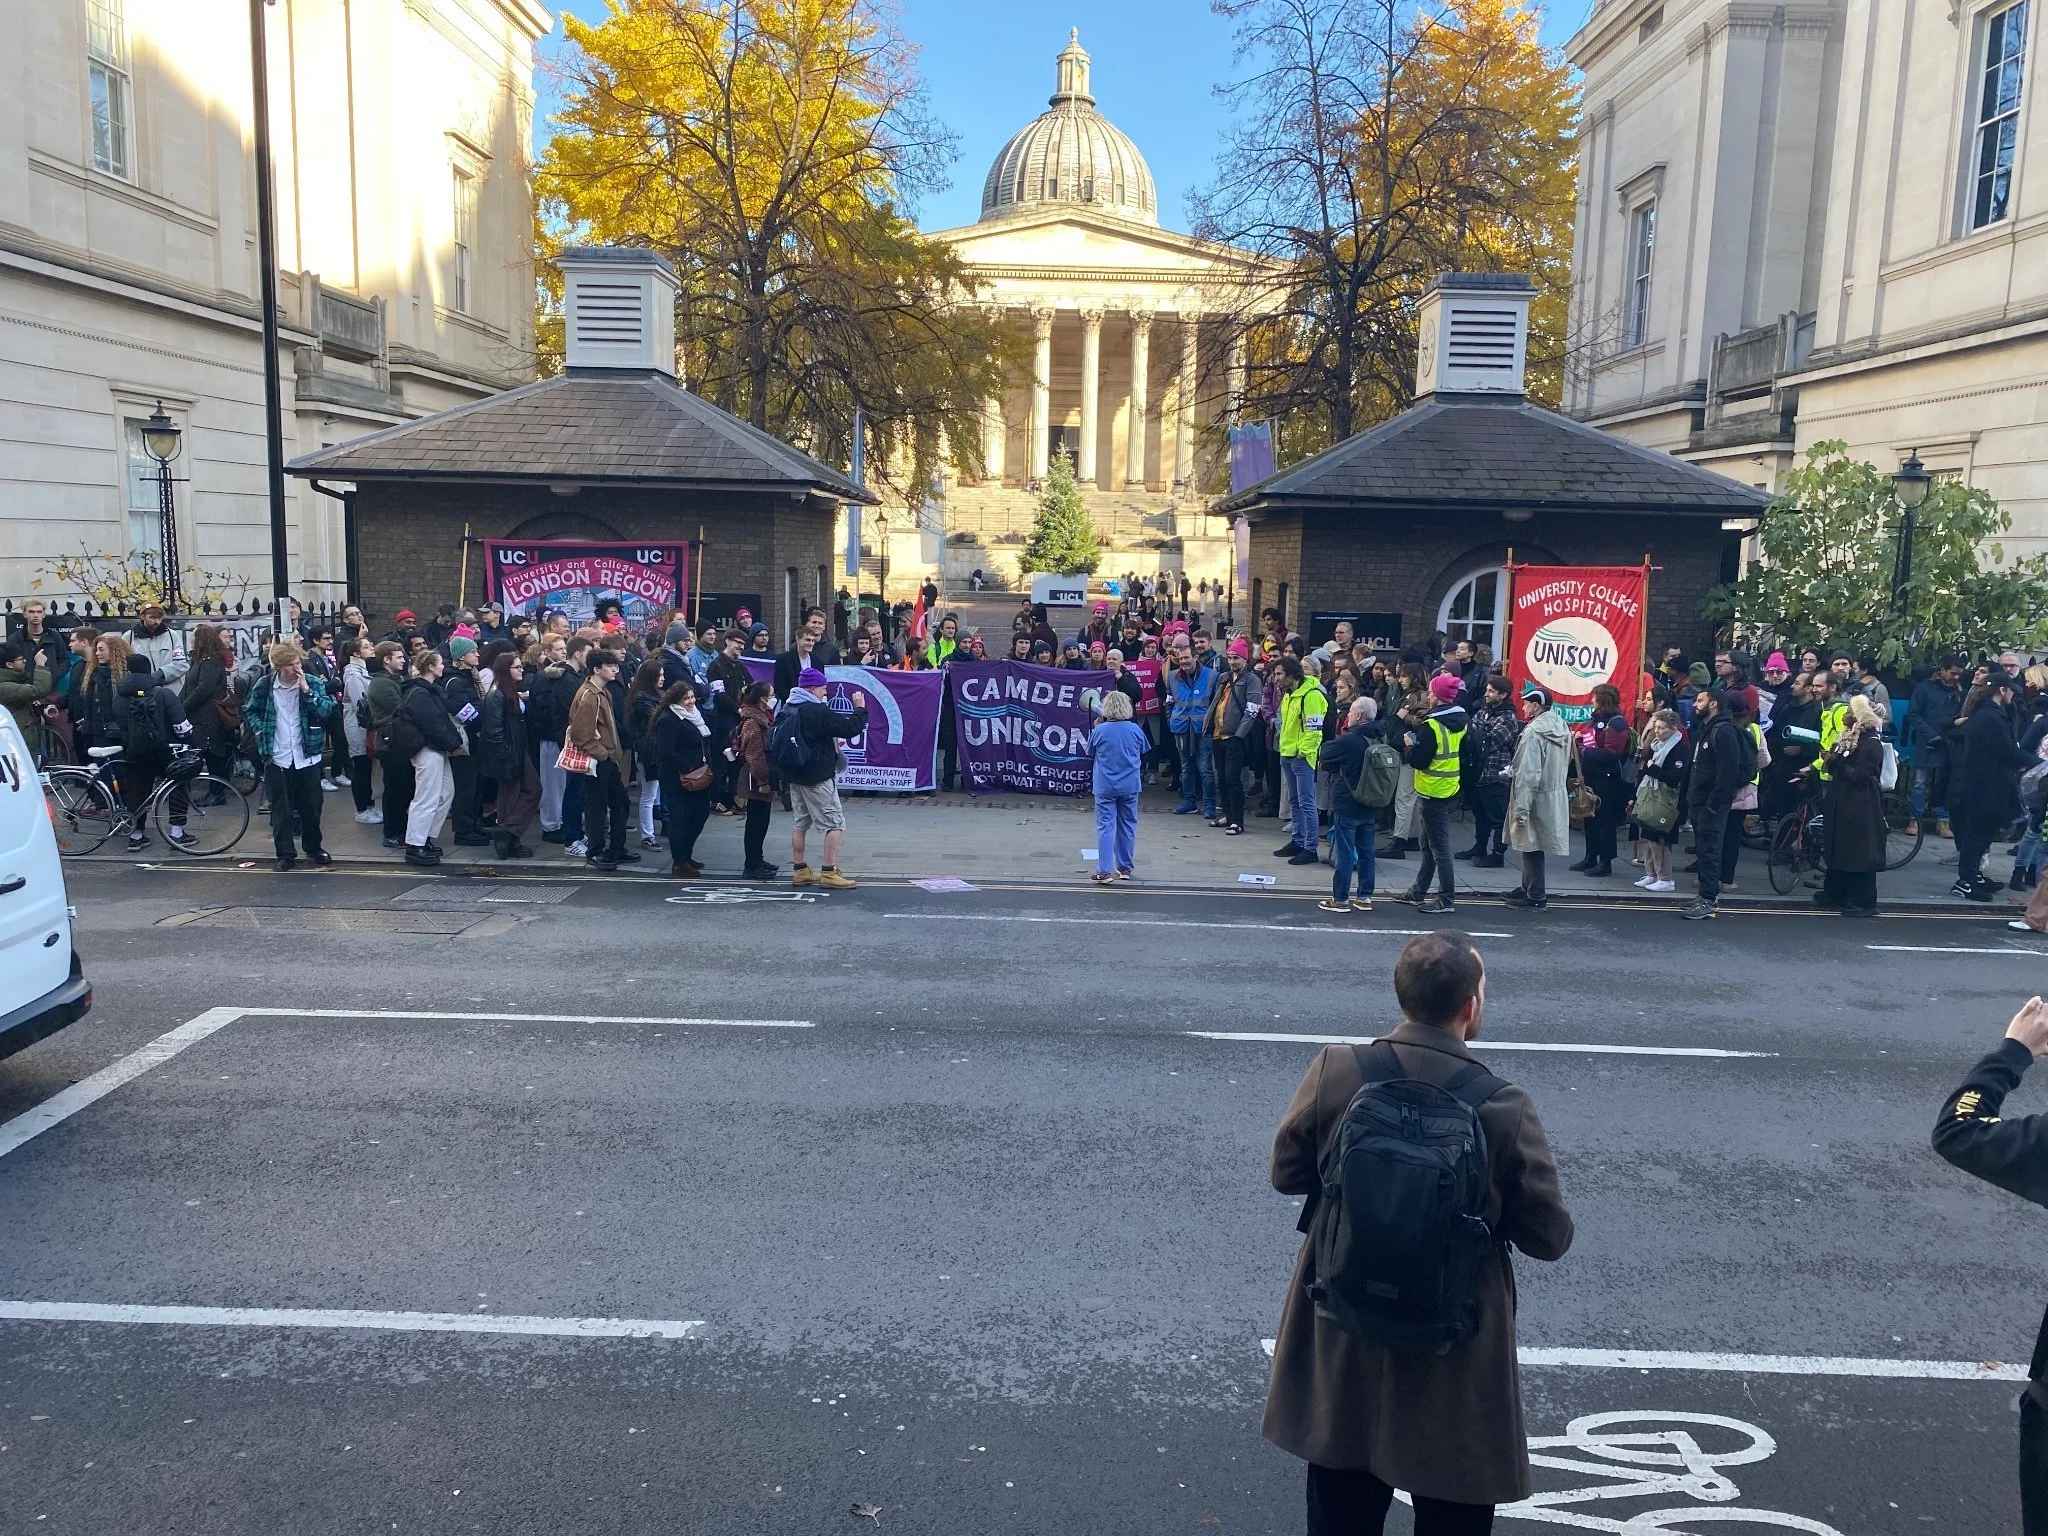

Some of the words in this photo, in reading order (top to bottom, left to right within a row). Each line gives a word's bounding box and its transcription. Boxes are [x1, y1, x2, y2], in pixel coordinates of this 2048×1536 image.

[505, 563, 560, 586] University
[567, 560, 586, 569] and
[594, 559, 634, 573] College
[642, 568, 671, 588] Union
[510, 569, 590, 602] LONDON
[600, 569, 669, 604] REGION
[1059, 592, 1082, 601] UCL
[1518, 580, 1586, 610] UNIVERSITY
[1588, 583, 1639, 619] COLLEGE
[1543, 597, 1609, 622] HOSPITAL
[1534, 640, 1608, 670] UNISON
[961, 675, 1103, 708] CAMDE
[964, 716, 1090, 756] UNISON
[838, 776, 843, 784] &
[845, 776, 887, 786] RESEARCH
[889, 779, 913, 787] STAFF
[1034, 765, 1092, 781] SERVICES
